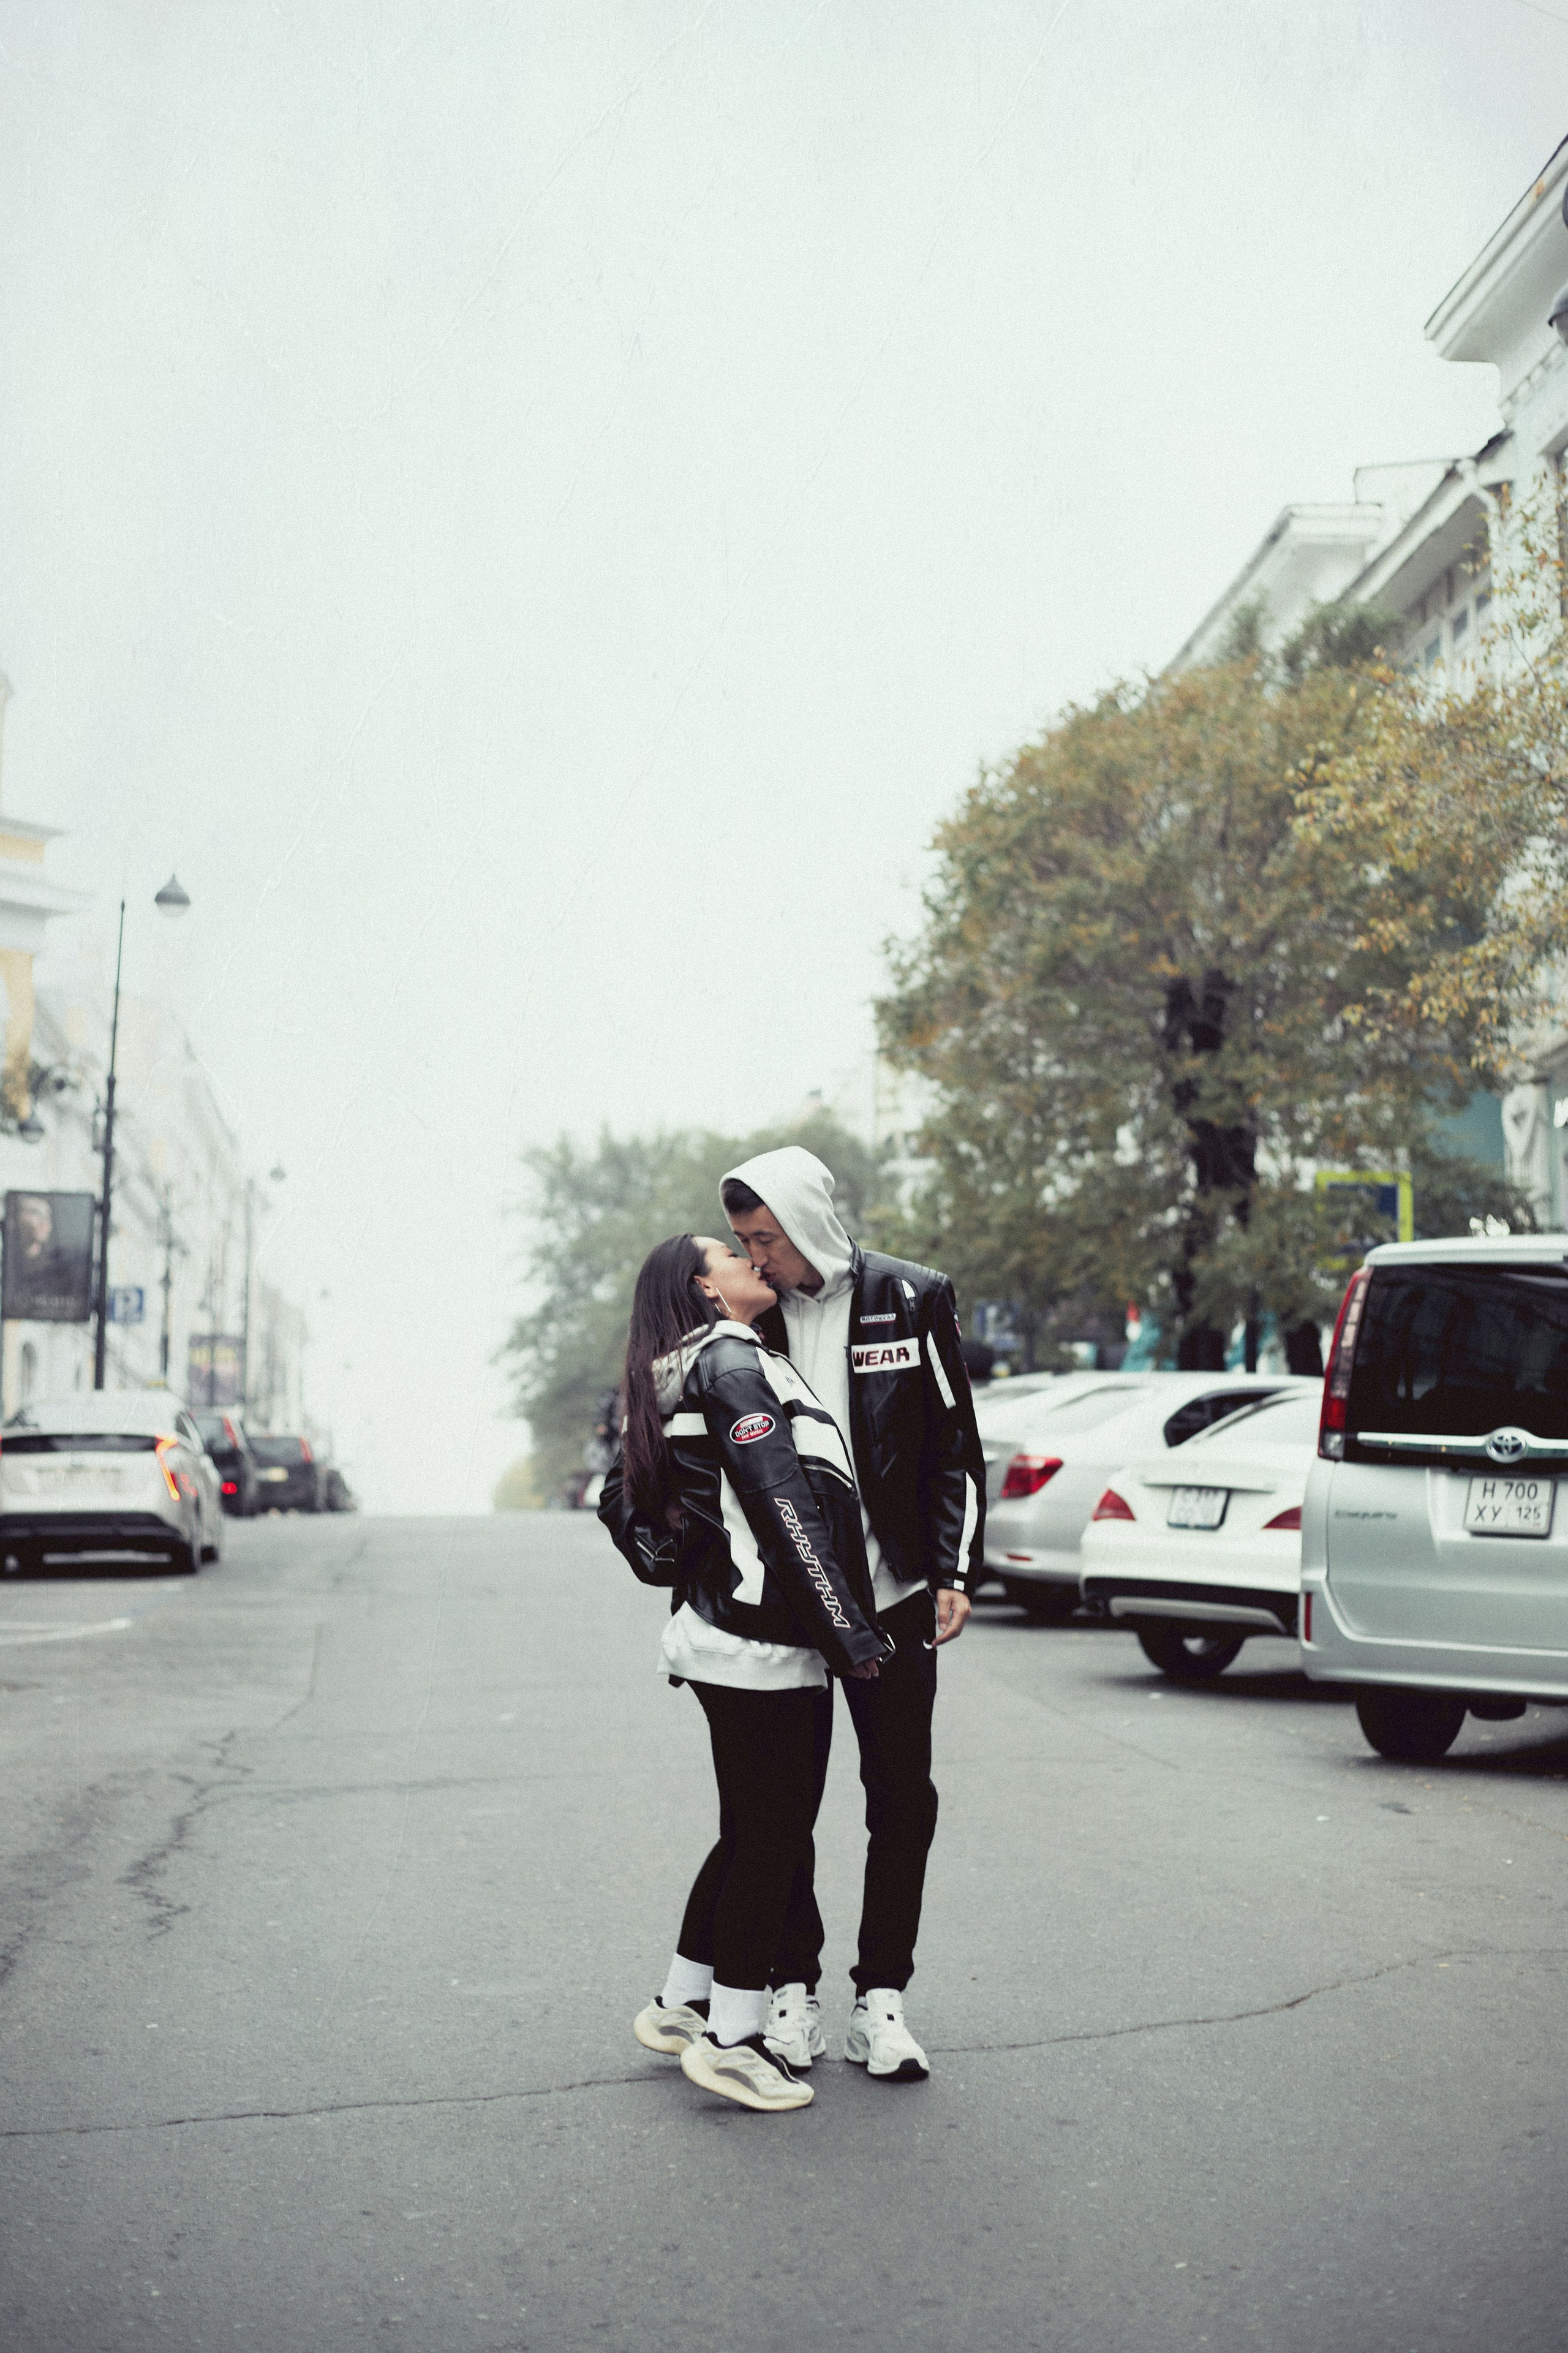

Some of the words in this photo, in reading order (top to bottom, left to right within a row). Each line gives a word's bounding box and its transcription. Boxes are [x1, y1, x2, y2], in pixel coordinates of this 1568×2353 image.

[853, 1346, 910, 1367] WEAR
[735, 1425, 752, 1437] DON'T
[753, 1421, 769, 1430] STOP
[1505, 1481, 1537, 1500] 700
[1517, 1506, 1540, 1519] 125
[774, 1498, 851, 1628] RHYTHM
